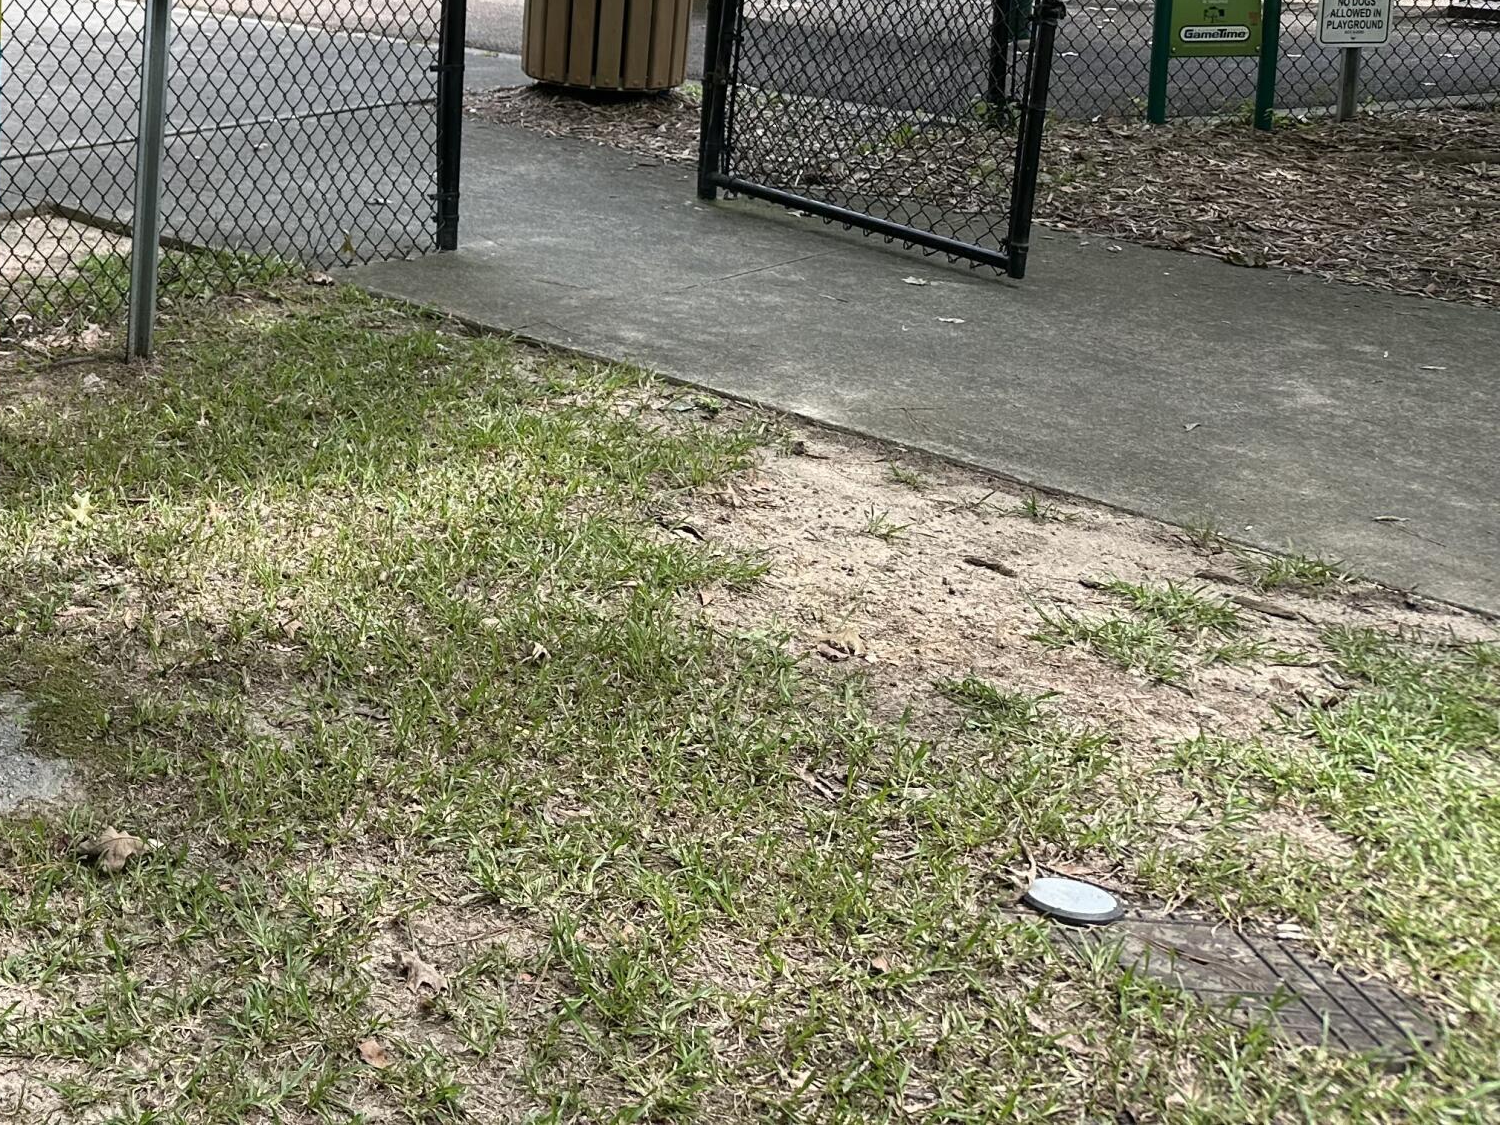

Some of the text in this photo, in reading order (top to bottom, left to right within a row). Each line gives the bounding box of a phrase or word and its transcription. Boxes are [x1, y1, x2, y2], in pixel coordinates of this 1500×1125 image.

[1329, 8, 1382, 18] ALLOWED IN
[1326, 19, 1384, 30] PLAYGROUND
[1184, 28, 1246, 39] GameTime
